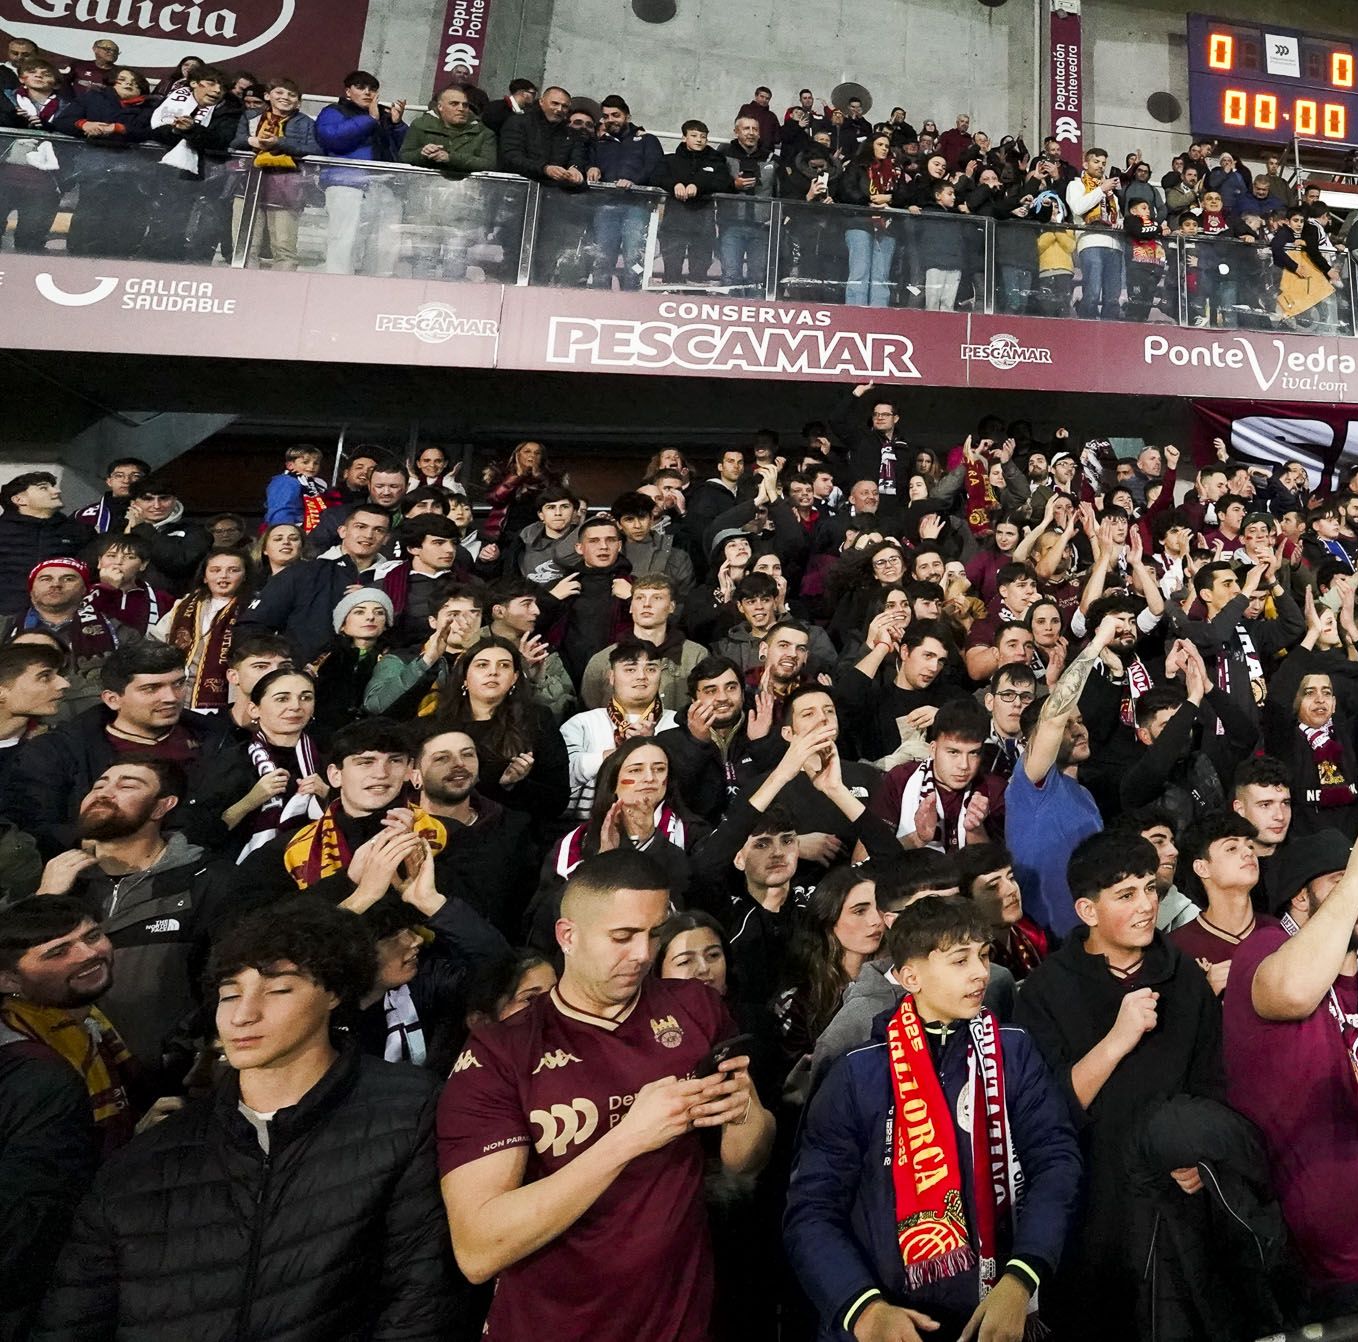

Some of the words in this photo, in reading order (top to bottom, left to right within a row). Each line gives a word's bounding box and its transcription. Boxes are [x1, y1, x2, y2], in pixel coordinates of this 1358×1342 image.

[1209, 33, 1233, 70] 0
[1331, 52, 1354, 87] 0
[1053, 43, 1069, 111] Deputación
[1066, 45, 1079, 112] Pontevedra
[125, 278, 213, 297] GALICIA
[121, 294, 237, 314] SAUDABLE
[658, 301, 832, 327] CONSERVAS
[375, 313, 500, 337] PESCAMAR
[546, 316, 923, 379] PESCAMAR
[960, 342, 1053, 365] PESCAMAR
[900, 1001, 925, 1052] 2025
[483, 1138, 505, 1153] NON
